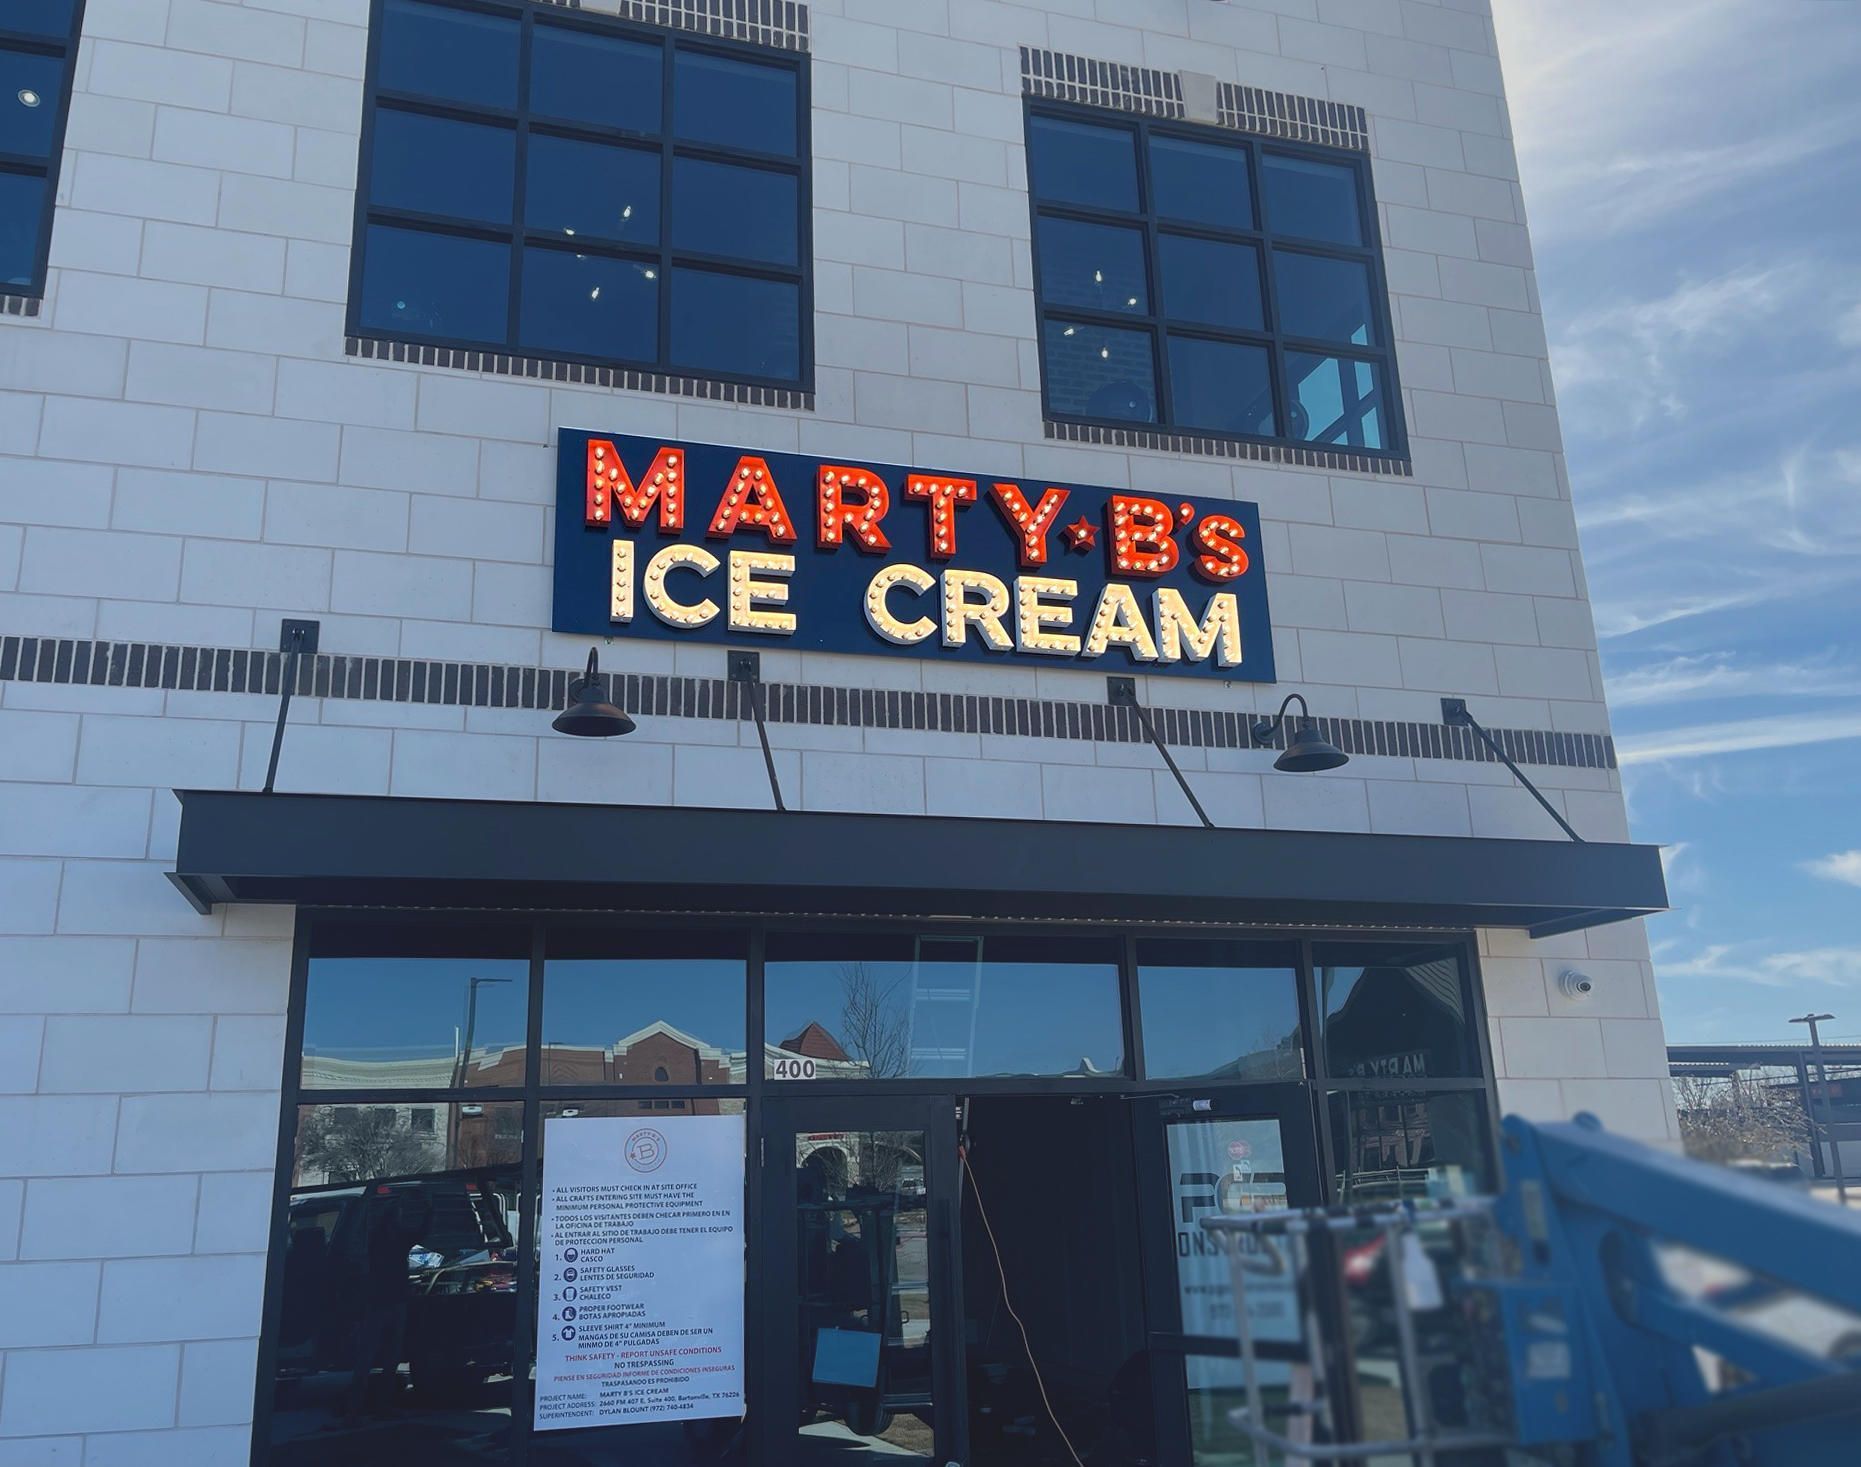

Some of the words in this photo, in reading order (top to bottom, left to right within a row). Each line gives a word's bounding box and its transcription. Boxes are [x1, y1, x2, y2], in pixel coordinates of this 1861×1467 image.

[584, 438, 1071, 567] MARTY
[1107, 494, 1250, 583] B's
[610, 539, 796, 635] ICE
[863, 563, 1242, 668] CREAM
[775, 1059, 815, 1078] 400
[678, 1347, 721, 1355] CONDITIONS
[627, 1360, 674, 1368] TRESPASSING
